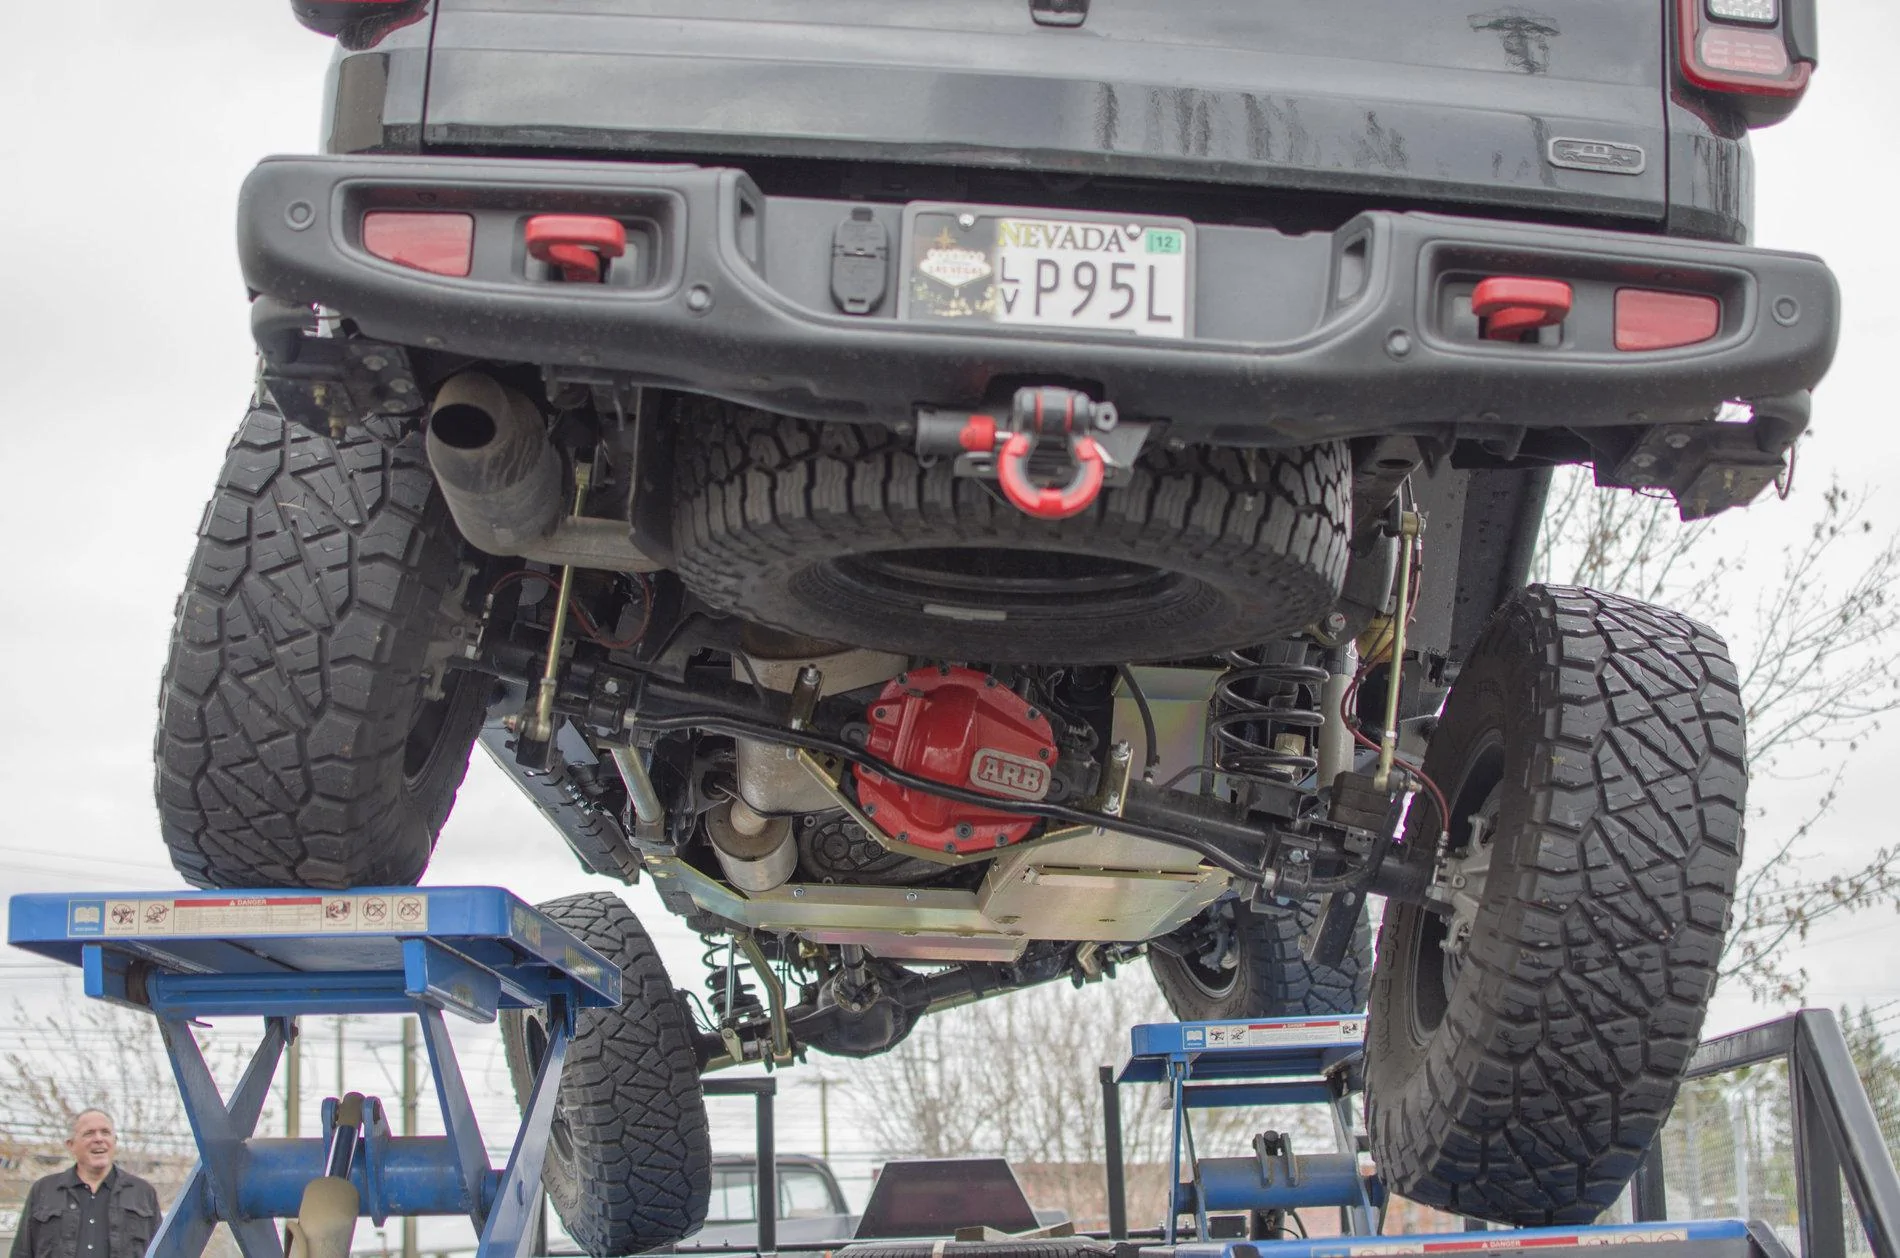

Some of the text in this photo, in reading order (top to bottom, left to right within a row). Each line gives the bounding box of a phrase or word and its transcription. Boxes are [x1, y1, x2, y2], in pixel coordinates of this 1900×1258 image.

[999, 223, 1125, 253] NEVADA
[1156, 236, 1174, 248] 12
[981, 757, 1040, 792] ARB
[237, 899, 267, 907] DANGER
